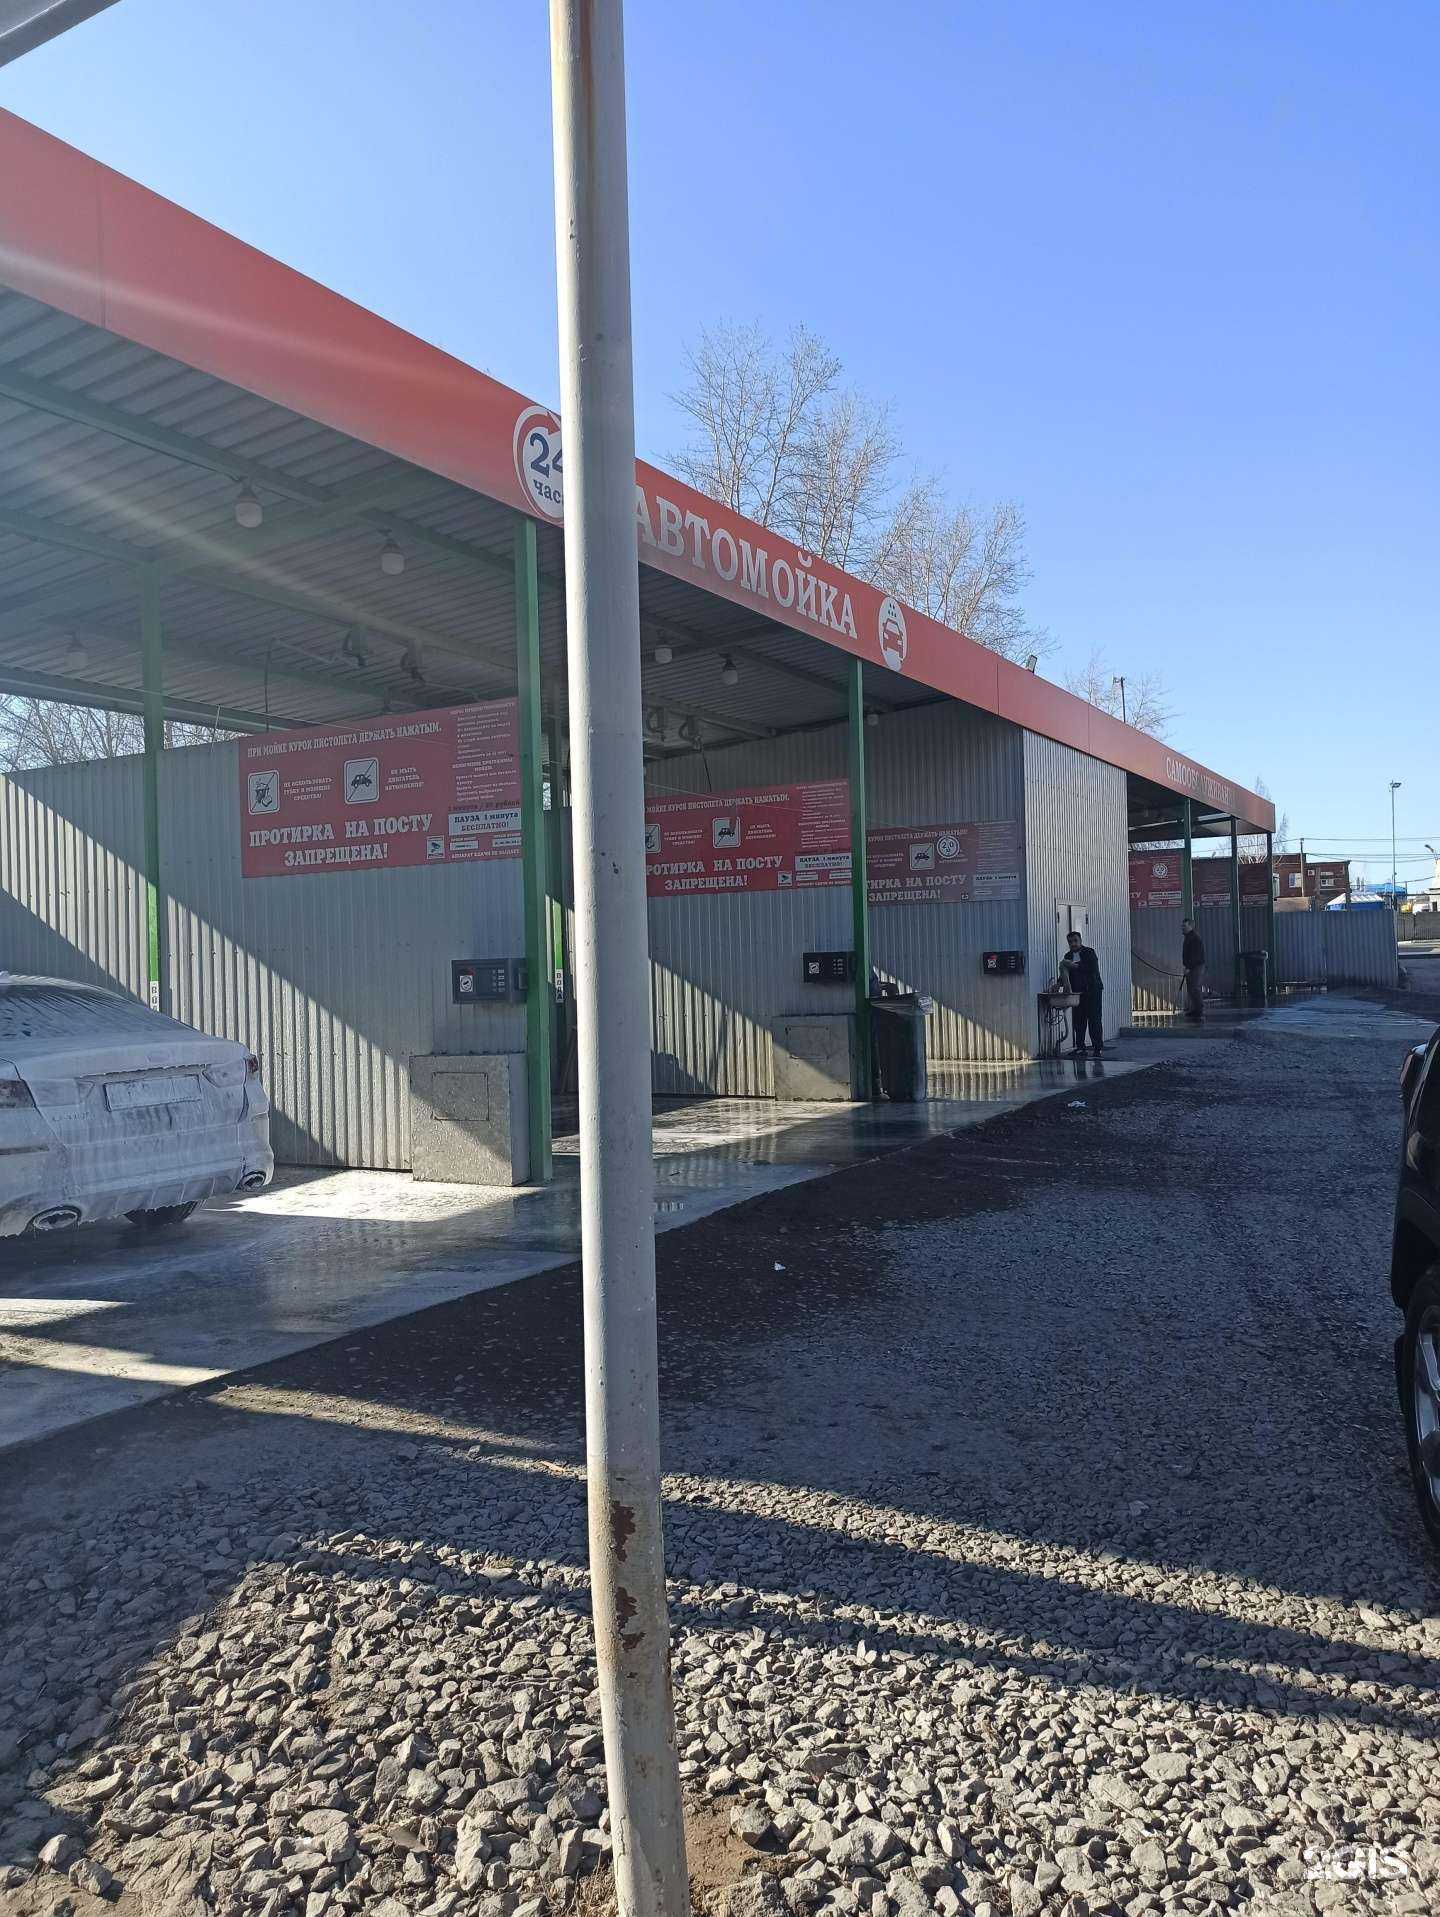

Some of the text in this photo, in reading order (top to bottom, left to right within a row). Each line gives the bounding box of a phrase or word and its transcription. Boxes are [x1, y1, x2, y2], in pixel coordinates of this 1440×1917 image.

[533, 479, 564, 504] час
[635, 485, 858, 640] АВТОМОЙКА
[248, 747, 260, 758] ПРИ
[263, 742, 288, 755] МОЙКЕ
[289, 738, 312, 752] КУРОК
[314, 734, 358, 748] ПИСТОЛЕТА
[359, 729, 396, 744] ДЕРЖАТЬ
[688, 800, 722, 810] ПИСТОЛЕТА
[454, 815, 480, 823] ПАУЗА
[488, 812, 518, 820] минута
[462, 820, 509, 832] БЕСПЛАТНО!
[249, 814, 432, 847] ПРОТИРКА НА ПОСТУ
[284, 843, 388, 867] ЗАПРЕЩЕНА!
[647, 856, 783, 876] РОТИРКА НА ПОСТУ
[664, 875, 748, 890] ЗАПРЕЩЕНА!
[866, 878, 900, 890] ТИРКА
[906, 876, 923, 887] НА
[926, 874, 968, 886] ПОСТУ
[868, 889, 941, 902] ЗАПРЕЩЕНА!
